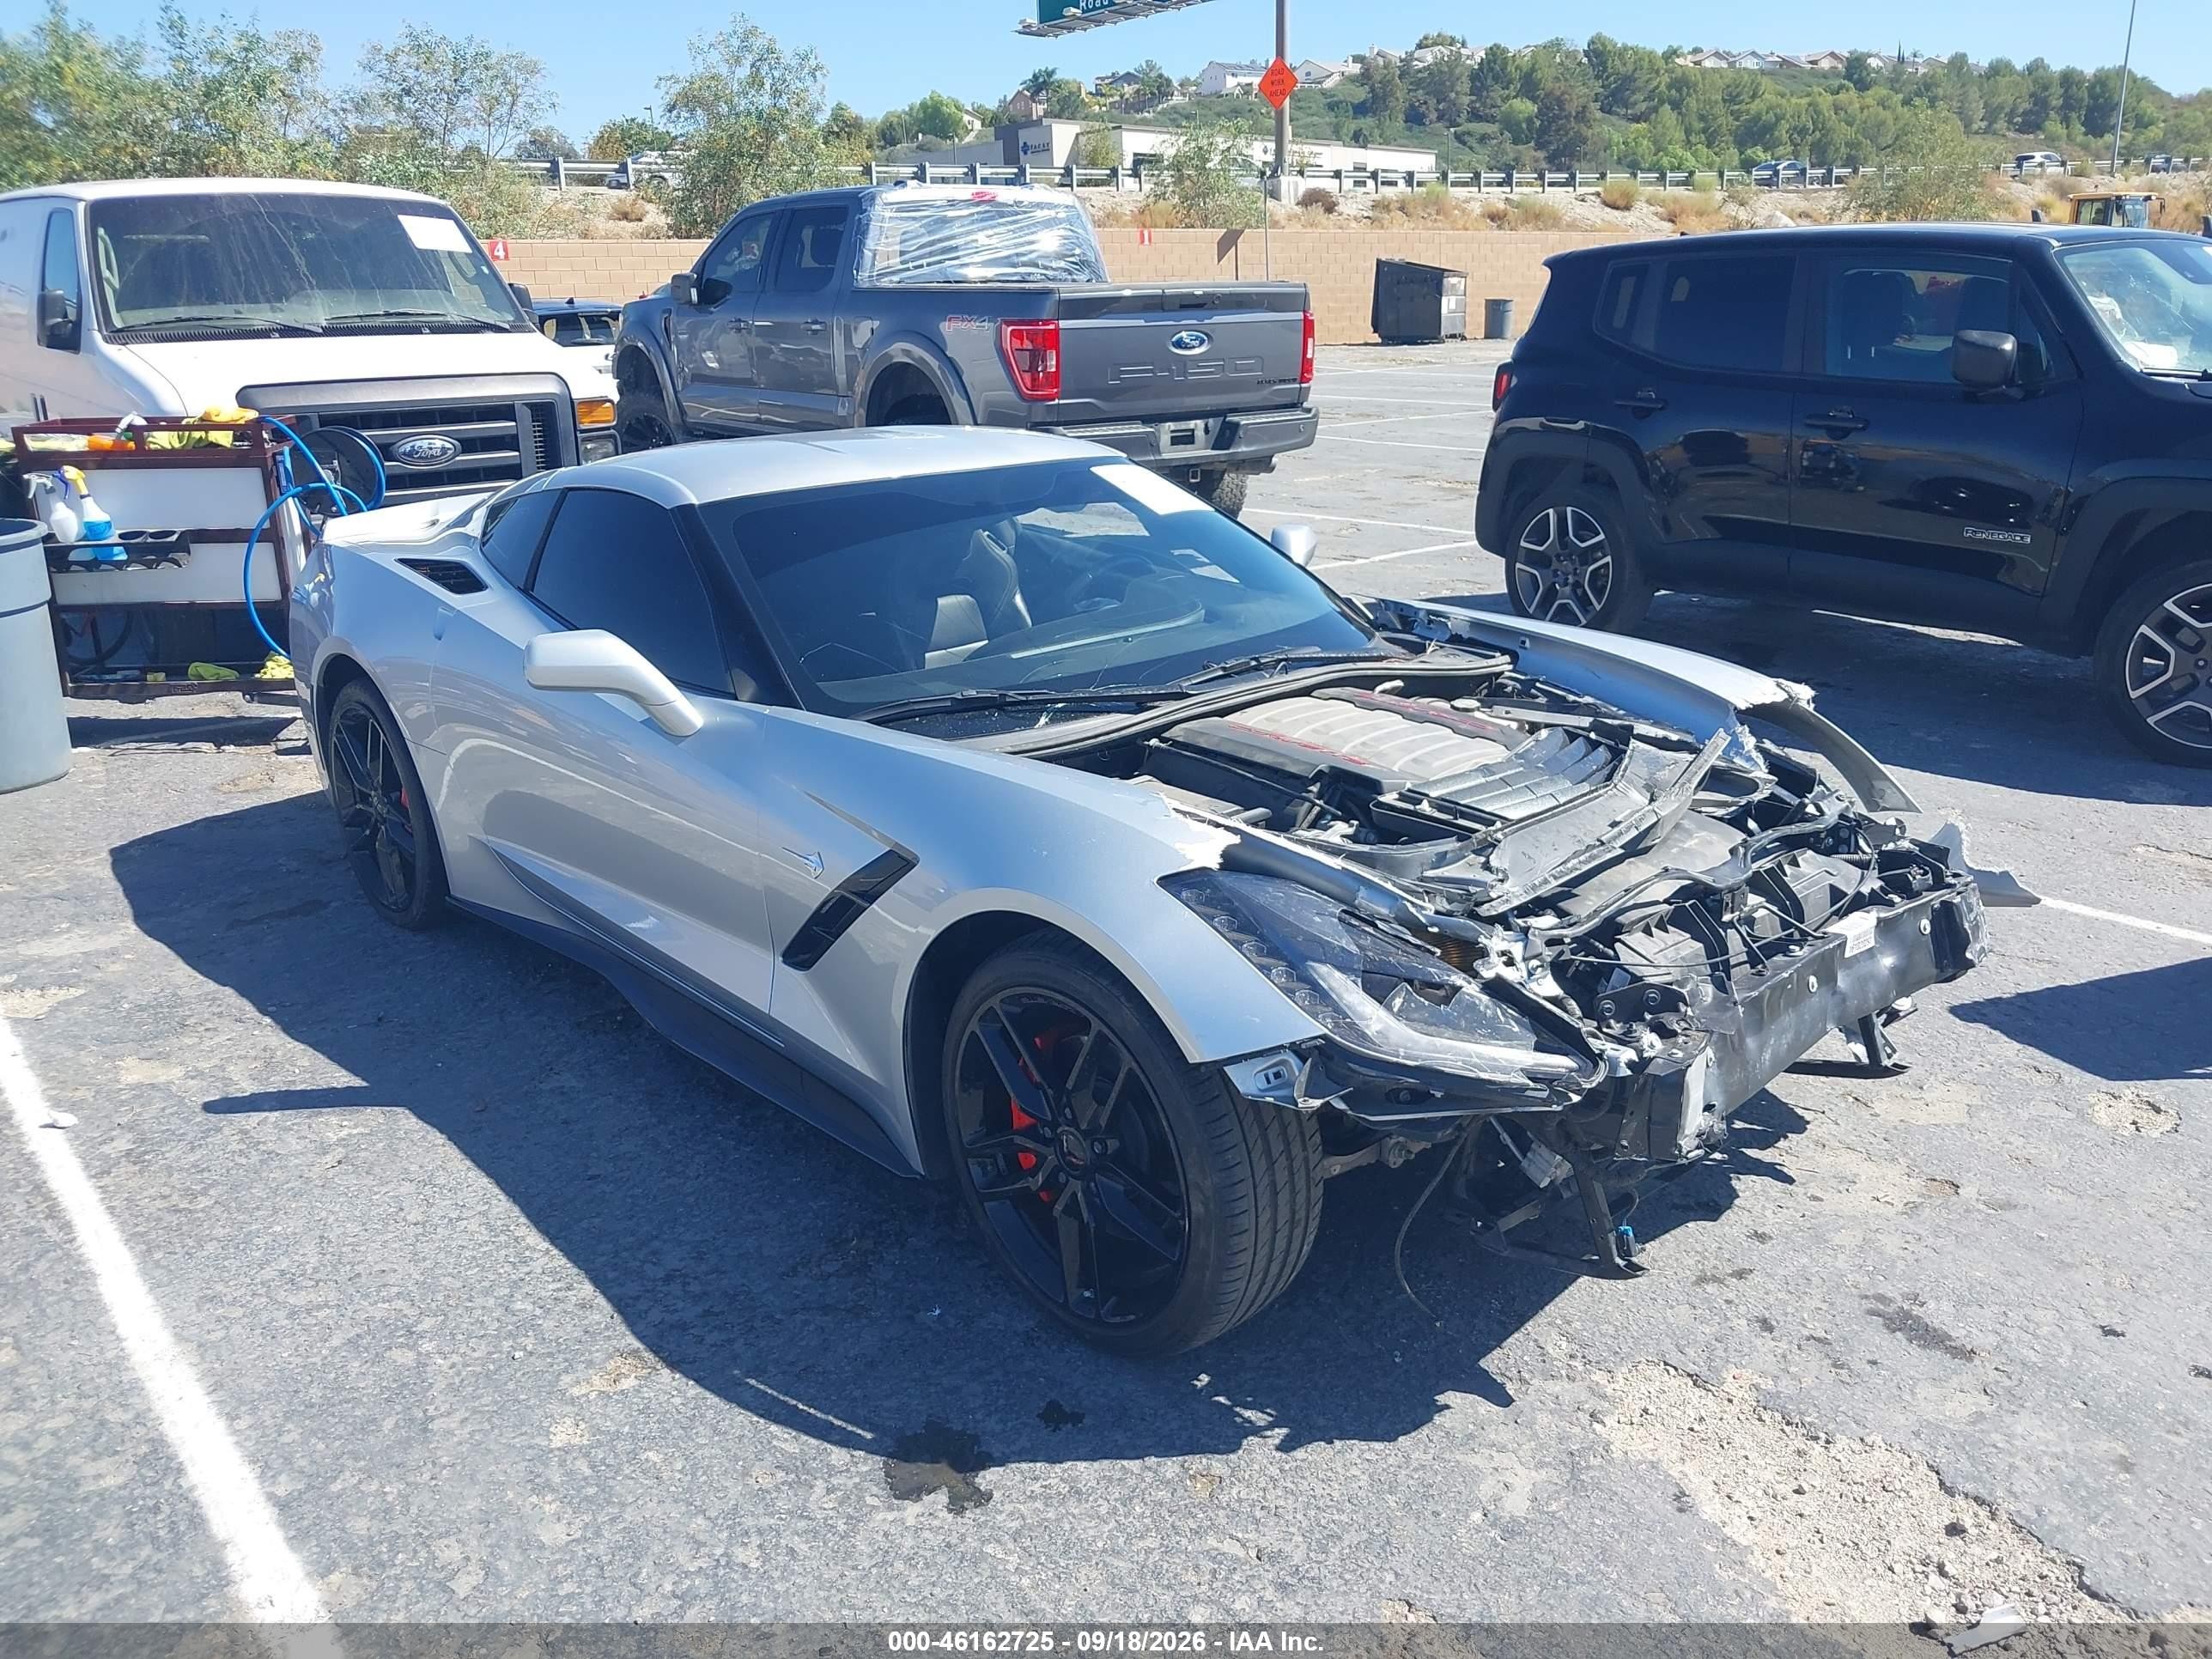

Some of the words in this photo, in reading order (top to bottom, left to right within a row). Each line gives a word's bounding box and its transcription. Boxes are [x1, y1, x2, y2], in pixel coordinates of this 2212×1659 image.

[1271, 68, 1285, 76] ROAD
[1269, 88, 1286, 97] AHEAD
[493, 240, 506, 260] 4
[945, 314, 989, 331] FX4
[1107, 356, 1264, 385] F-150
[412, 445, 443, 459] Ford
[1963, 526, 2032, 544] RENEGADE
